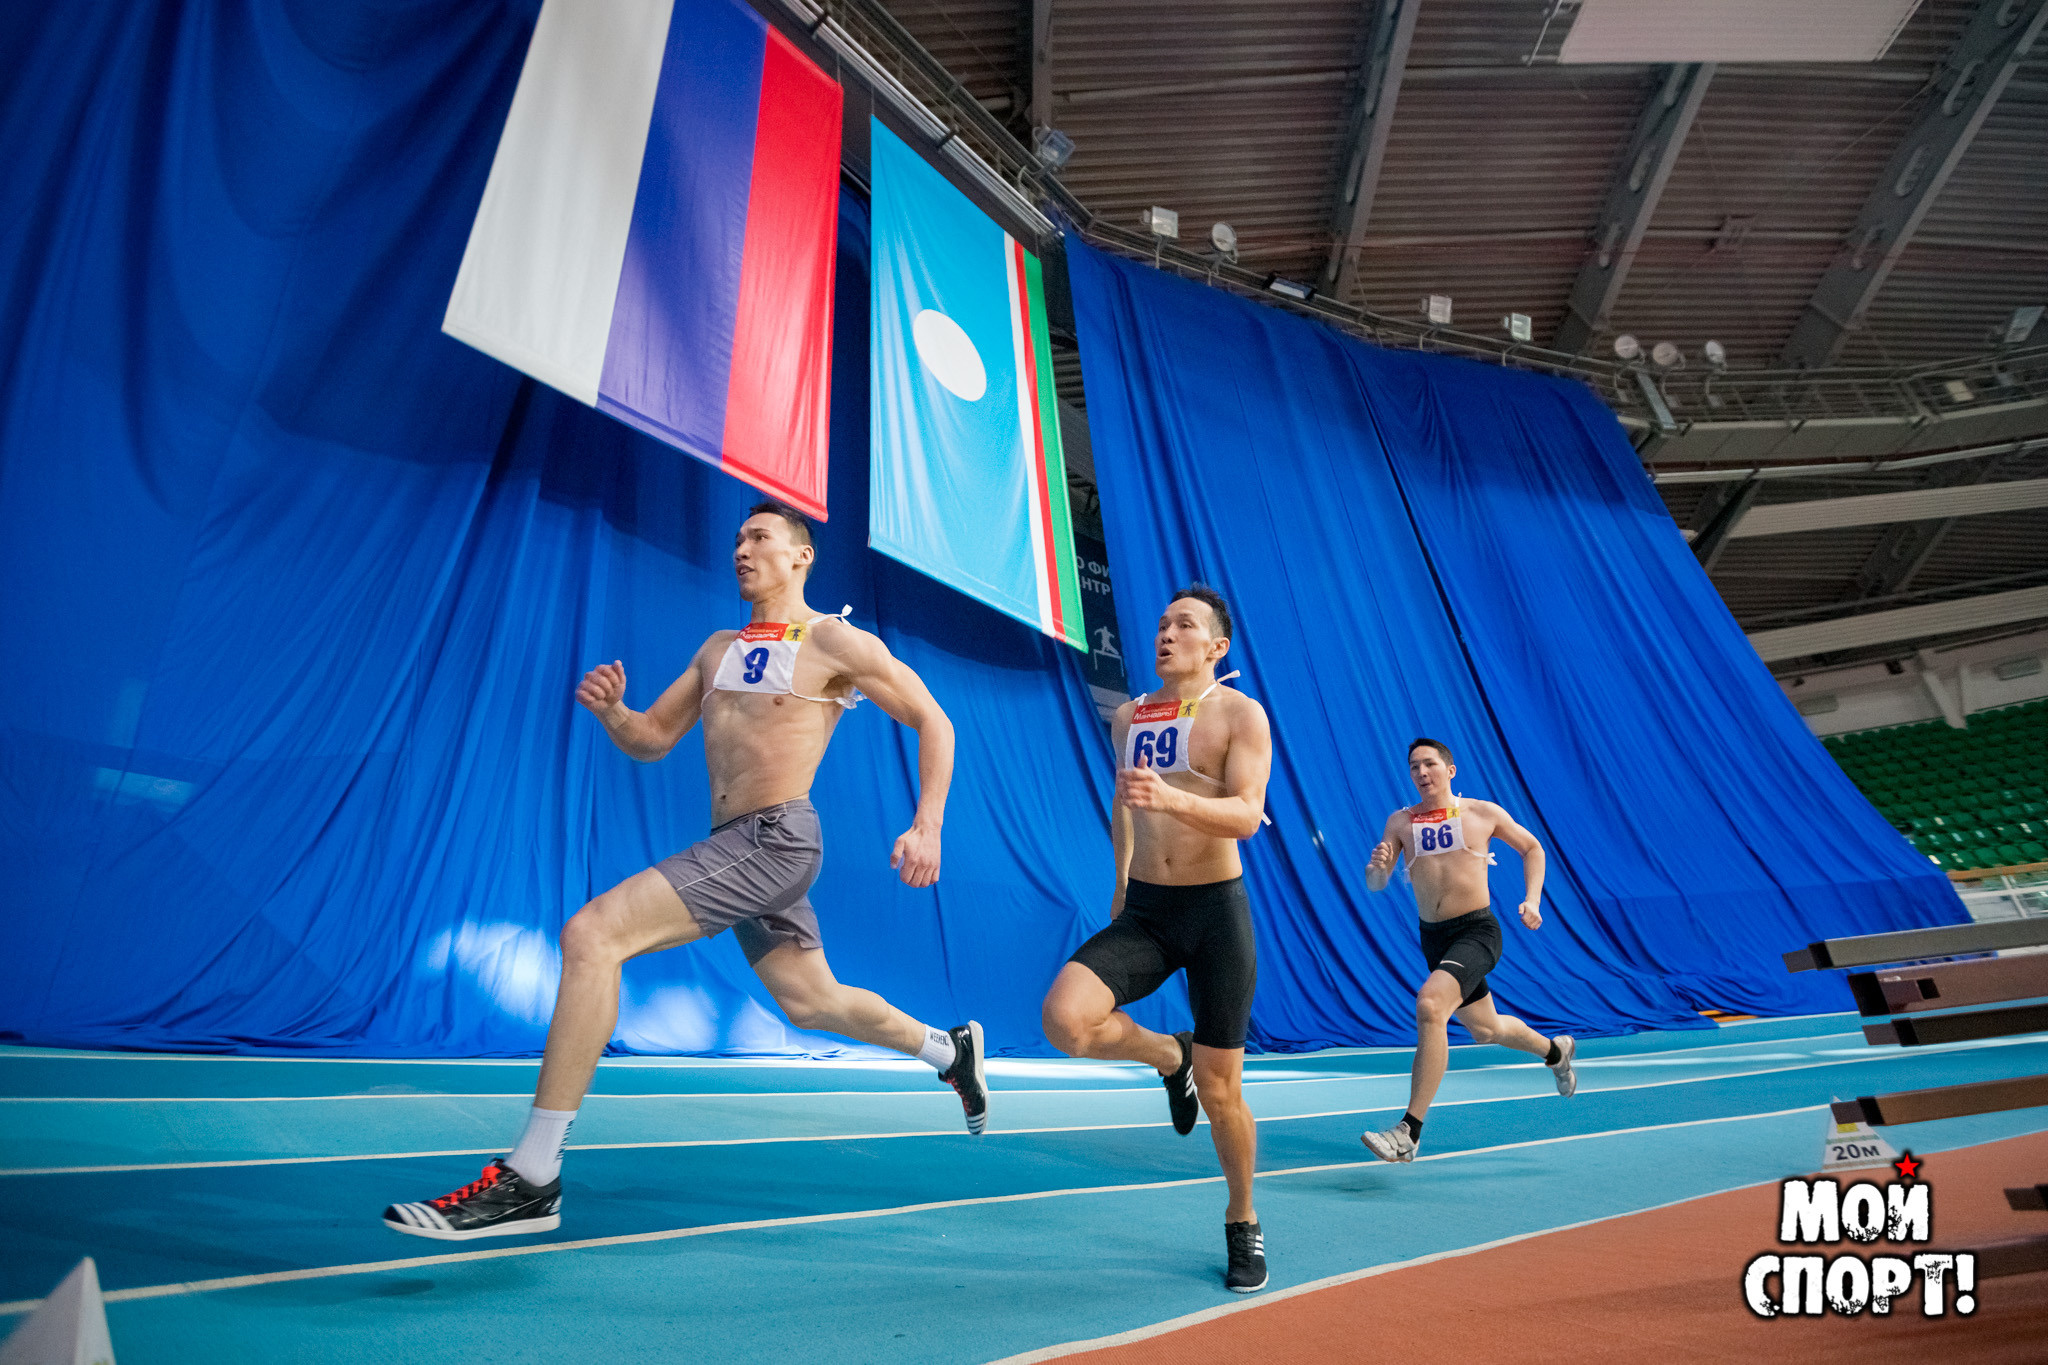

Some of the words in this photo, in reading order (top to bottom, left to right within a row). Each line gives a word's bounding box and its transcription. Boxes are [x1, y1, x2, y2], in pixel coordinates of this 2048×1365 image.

[1079, 576, 1111, 596] НТР
[742, 647, 770, 684] 9
[1133, 727, 1178, 768] 69
[1422, 824, 1453, 851] 86
